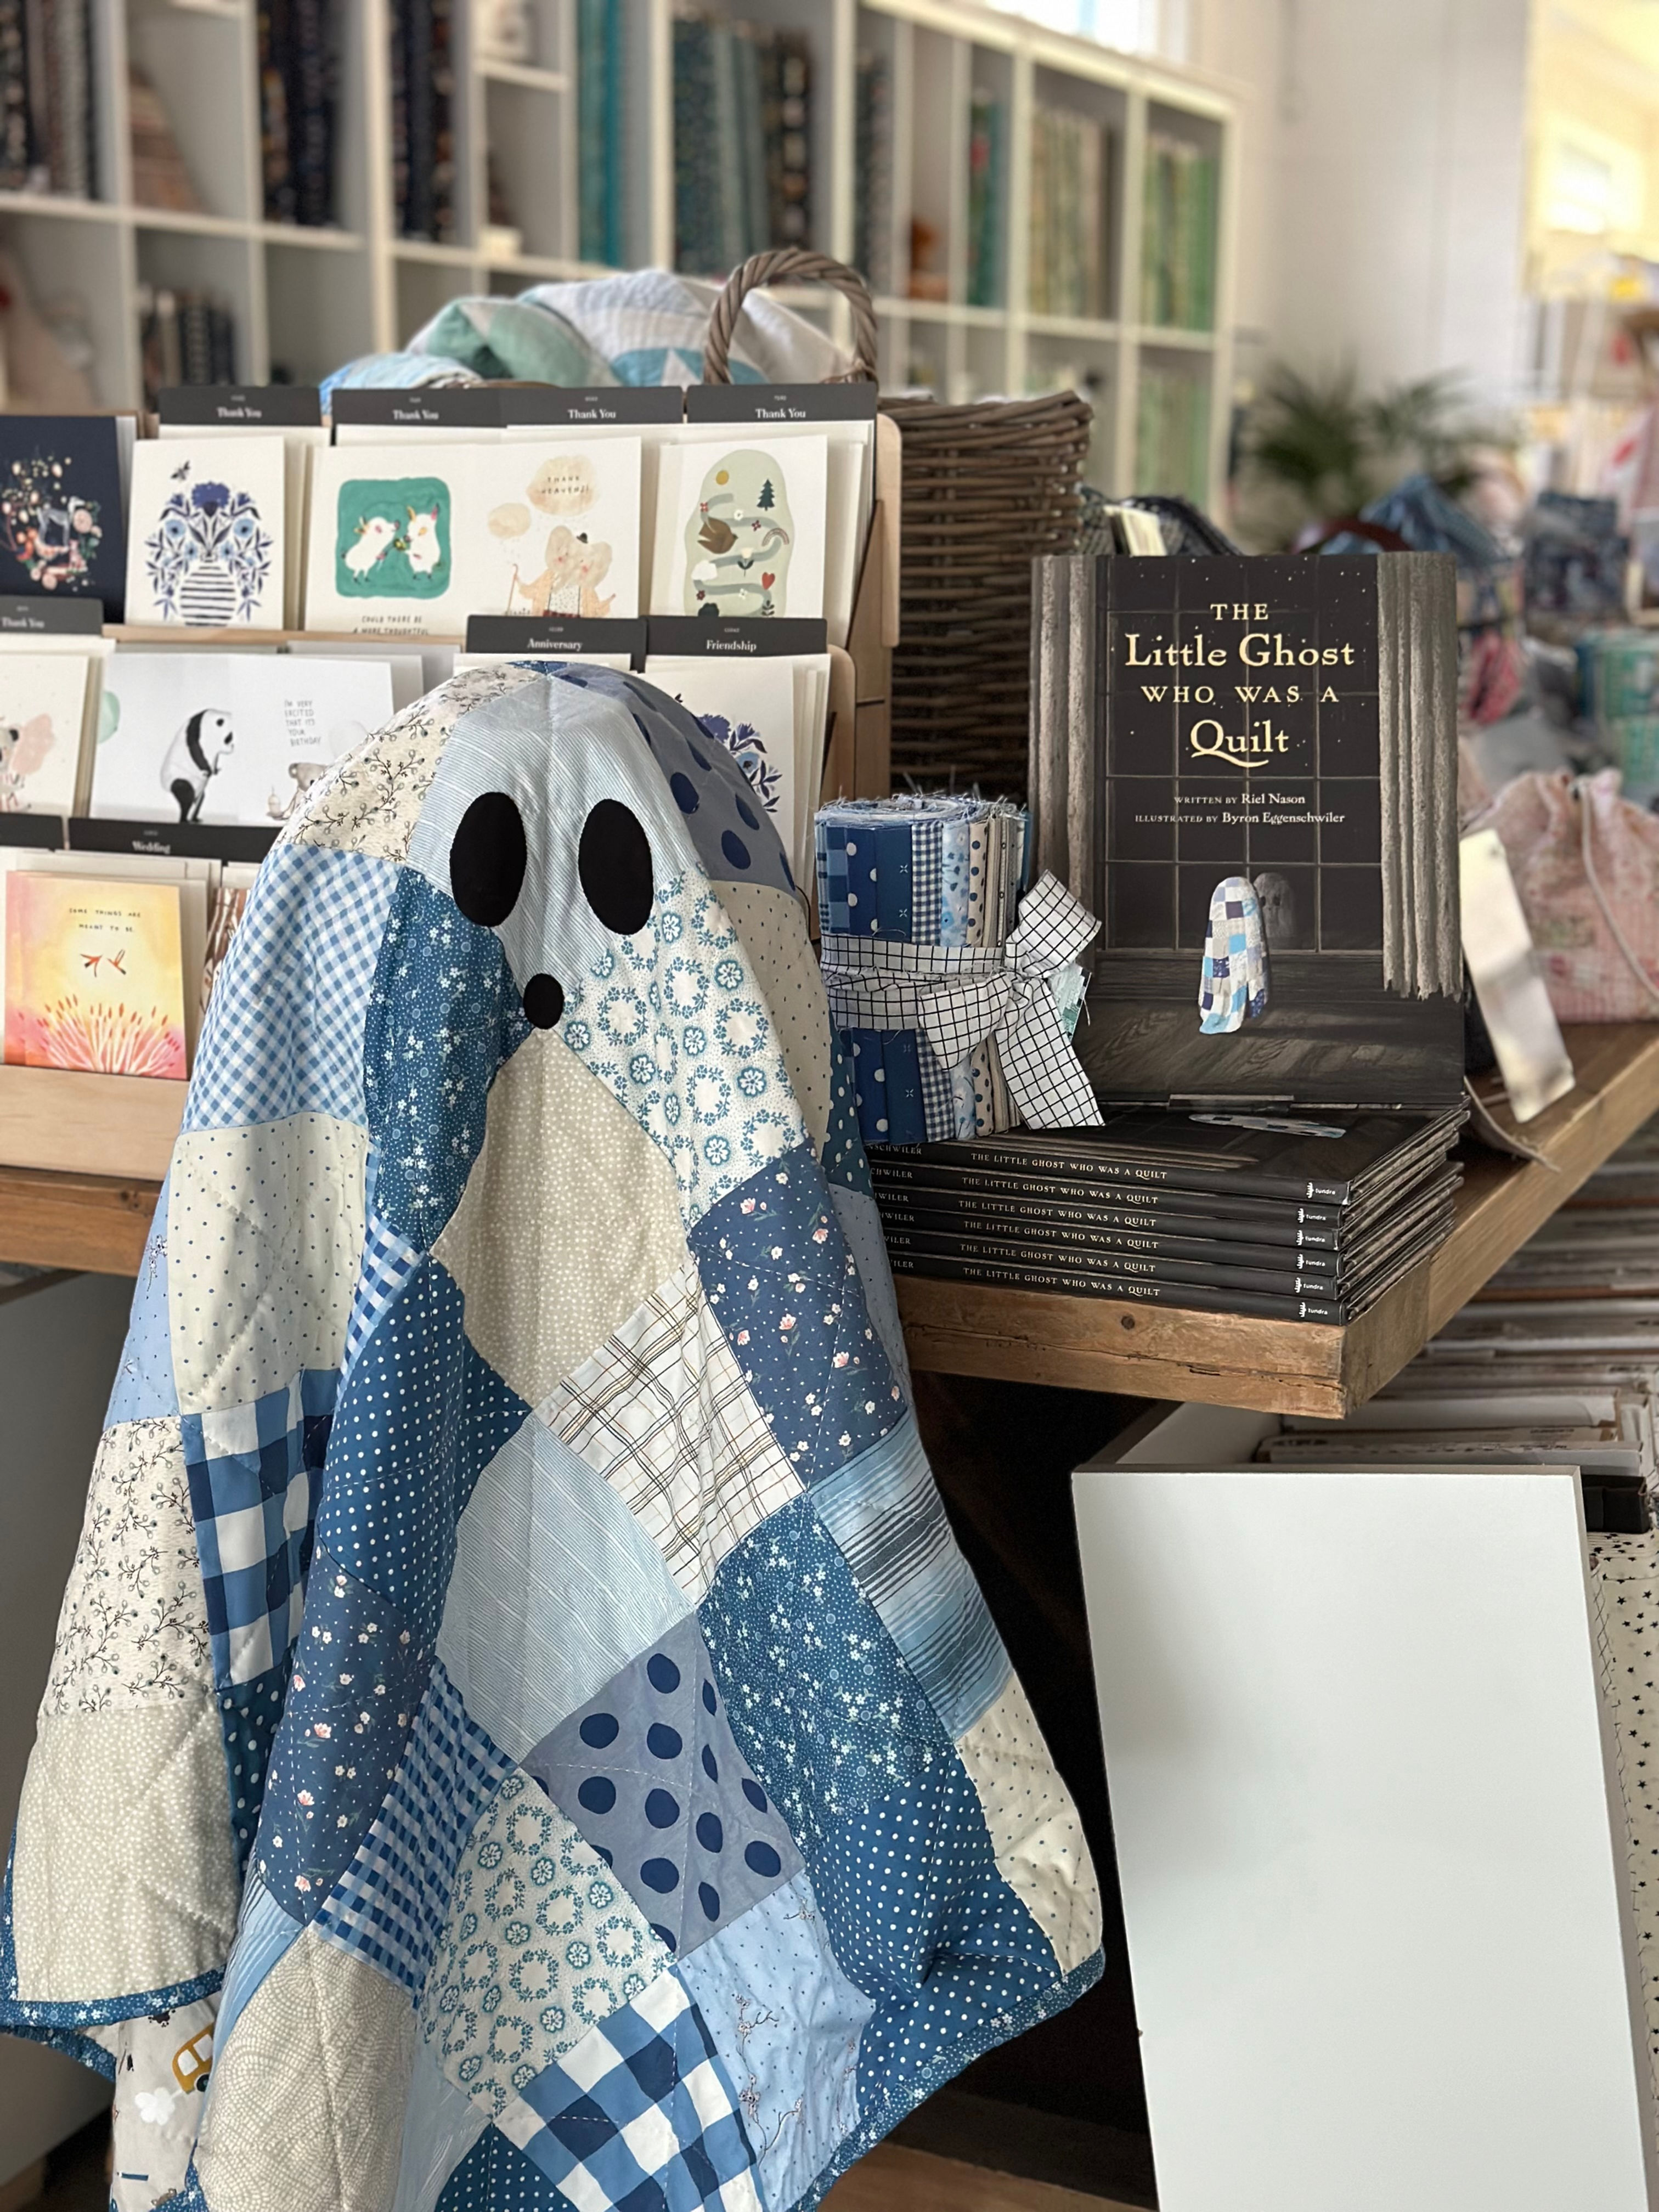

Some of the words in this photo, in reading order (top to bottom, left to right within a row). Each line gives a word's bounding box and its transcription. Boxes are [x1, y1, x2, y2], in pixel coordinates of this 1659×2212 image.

[217, 407, 244, 417] Thank
[245, 407, 262, 418] You
[392, 409, 421, 420] Thank
[421, 409, 439, 420] You
[567, 409, 597, 419] Thank
[599, 409, 616, 419] You
[755, 408, 786, 418] Thank
[788, 408, 806, 418] You
[1210, 603, 1269, 620] THE
[2, 617, 27, 628] Thank
[28, 617, 45, 629] You
[527, 637, 583, 652] Anniversary
[706, 640, 757, 652] Friendship
[1125, 633, 1227, 667] Little
[1239, 633, 1355, 667] Ghost
[1141, 686, 1215, 703] WHO
[1234, 686, 1300, 703] WAS
[1320, 686, 1340, 703] A
[1190, 719, 1289, 768] Quilt
[1241, 794, 1265, 804] Riel
[1268, 794, 1306, 804] Nason
[1222, 812, 1259, 825] Byron
[1262, 811, 1346, 825] Eggenschwiler
[132, 840, 171, 855] Wedding
[994, 1155, 1028, 1165] LITTLE
[1031, 1159, 1065, 1169] GHOST
[1069, 1163, 1093, 1172] WHO
[1098, 1166, 1120, 1174] WAS
[1135, 1169, 1168, 1180] QUILT
[985, 1179, 1019, 1189] LITTLE
[1022, 1183, 1056, 1193] GHOST
[1059, 1187, 1085, 1196] WHO
[1088, 1190, 1111, 1199] WAS
[1126, 1194, 1159, 1204] QUILT
[981, 1203, 1015, 1212] LITTLE
[1019, 1206, 1054, 1216] GHOST
[1057, 1210, 1082, 1220] WHO
[1086, 1212, 1109, 1221] WAS
[1124, 1216, 1158, 1227] QUILT
[986, 1223, 1020, 1233] LITTLE
[1024, 1227, 1058, 1237] GHOST
[1061, 1232, 1086, 1240] WHO
[1090, 1234, 1111, 1243] WAS
[1127, 1239, 1160, 1250] QUILT
[960, 1244, 978, 1252] THE
[983, 1246, 1017, 1256] LITTLE
[1020, 1251, 1054, 1261] GHOST
[1058, 1254, 1082, 1264] WHO
[1086, 1257, 1108, 1267] WAS
[1124, 1262, 1156, 1273] QUILT
[963, 1267, 982, 1276] THE
[986, 1270, 1020, 1280] LITTLE
[1024, 1275, 1058, 1284] GHOST
[1062, 1278, 1086, 1288] WHO
[1090, 1282, 1113, 1290] WAS
[1128, 1286, 1161, 1296] QUILT
